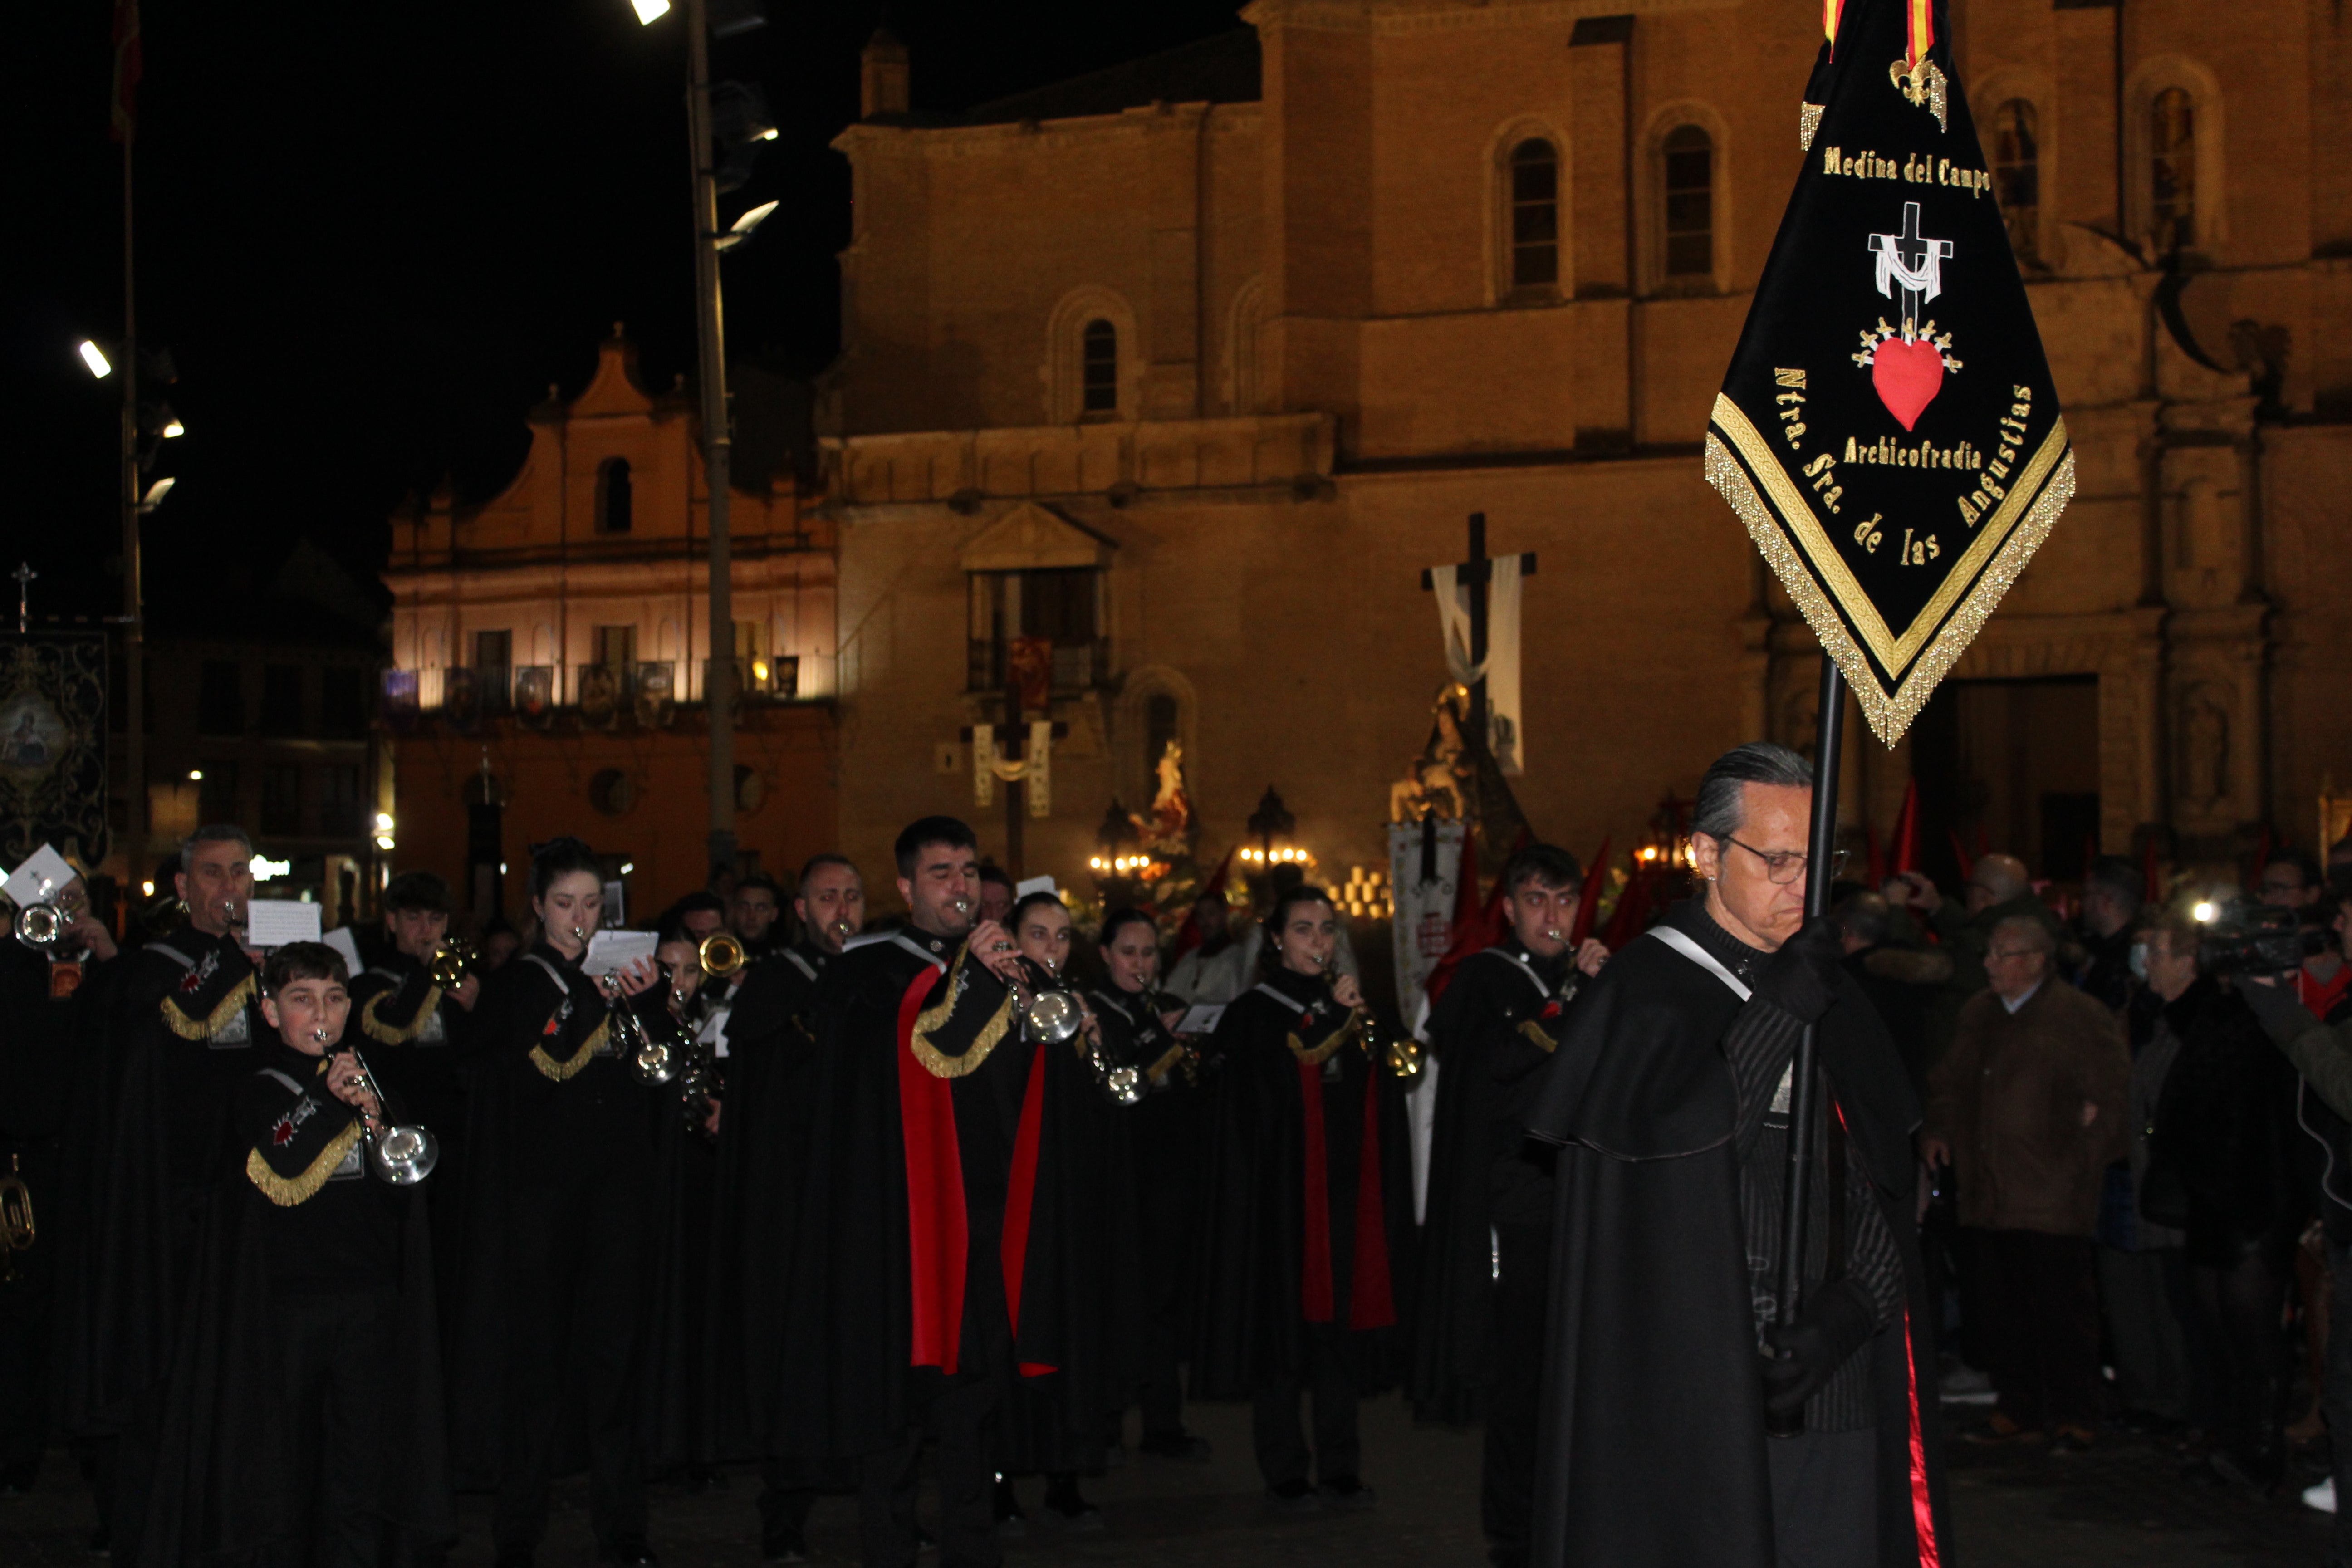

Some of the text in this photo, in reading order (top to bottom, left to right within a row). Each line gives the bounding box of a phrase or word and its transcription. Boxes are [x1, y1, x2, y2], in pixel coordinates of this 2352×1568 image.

[1823, 147, 1990, 199] Medina del Campo
[1774, 367, 2031, 565] Ntra. Sra. de las Angustias
[1843, 436, 1981, 470] Archicofradia
